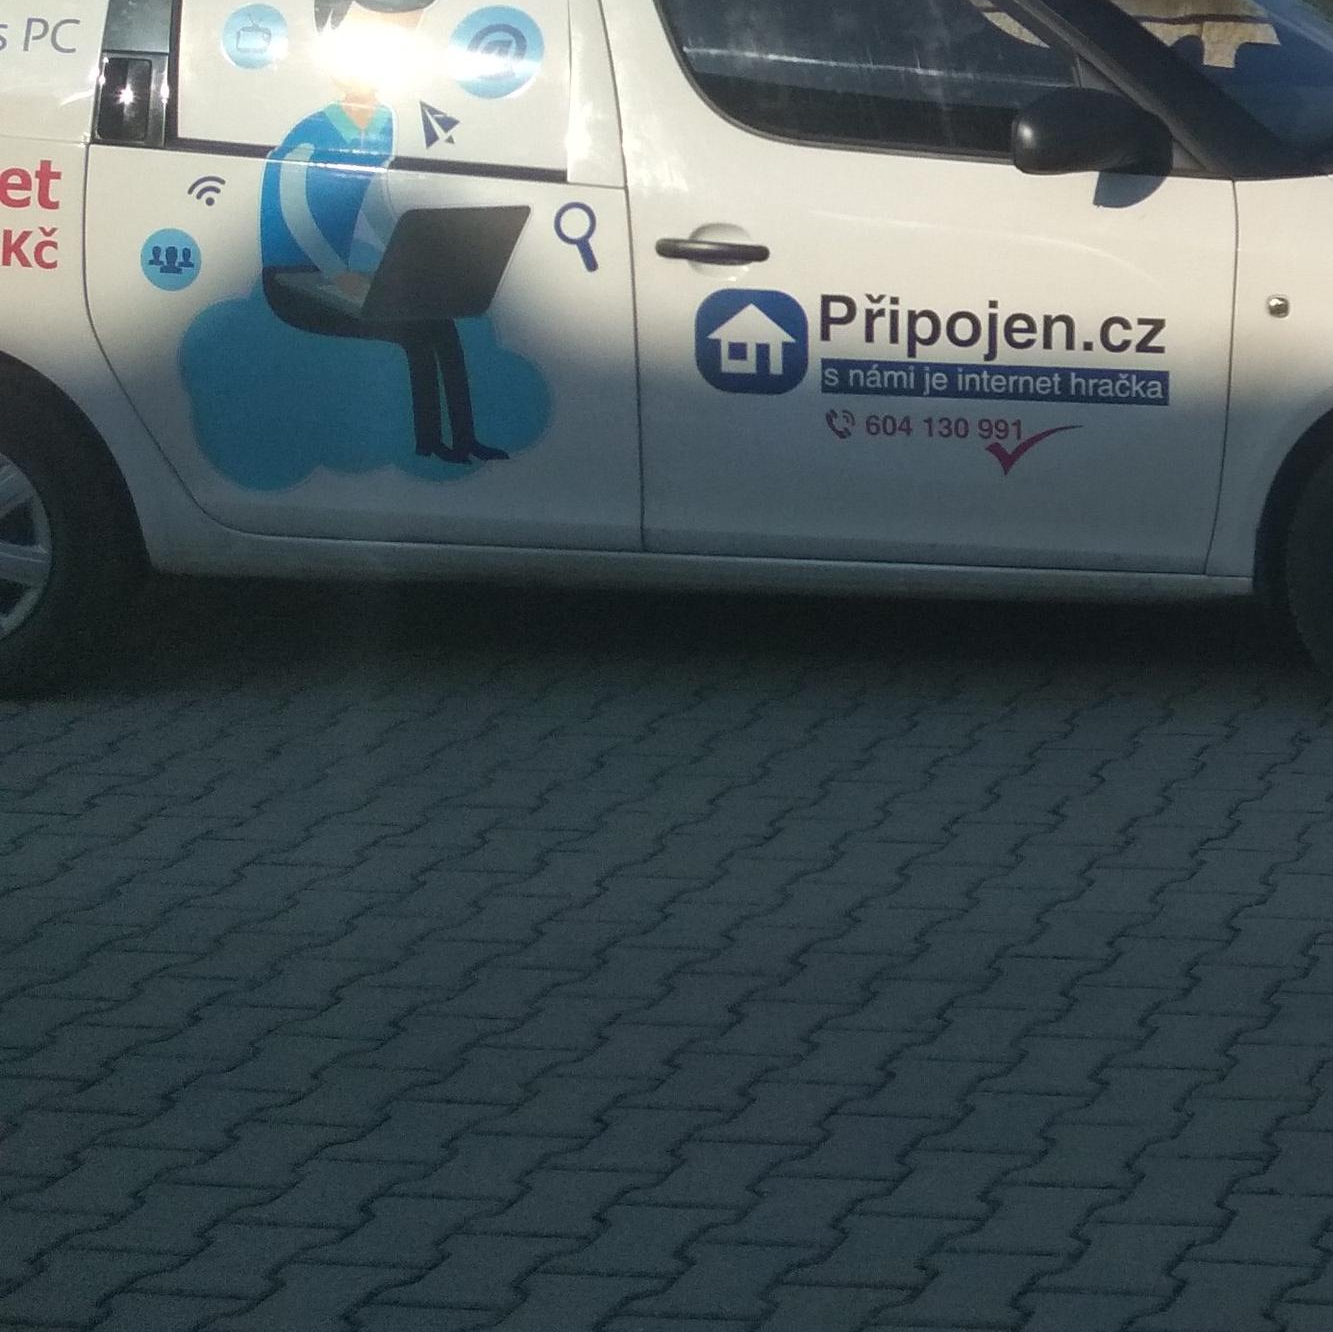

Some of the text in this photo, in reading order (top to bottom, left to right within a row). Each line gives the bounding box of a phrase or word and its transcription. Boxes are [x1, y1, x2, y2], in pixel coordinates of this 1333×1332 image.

[23, 17, 81, 54] PC
[2, 226, 59, 270] Kč
[819, 293, 1167, 361] Připojen.cz
[824, 364, 1164, 399] s námi je internet hračka
[865, 414, 1024, 441] 604 130 991
